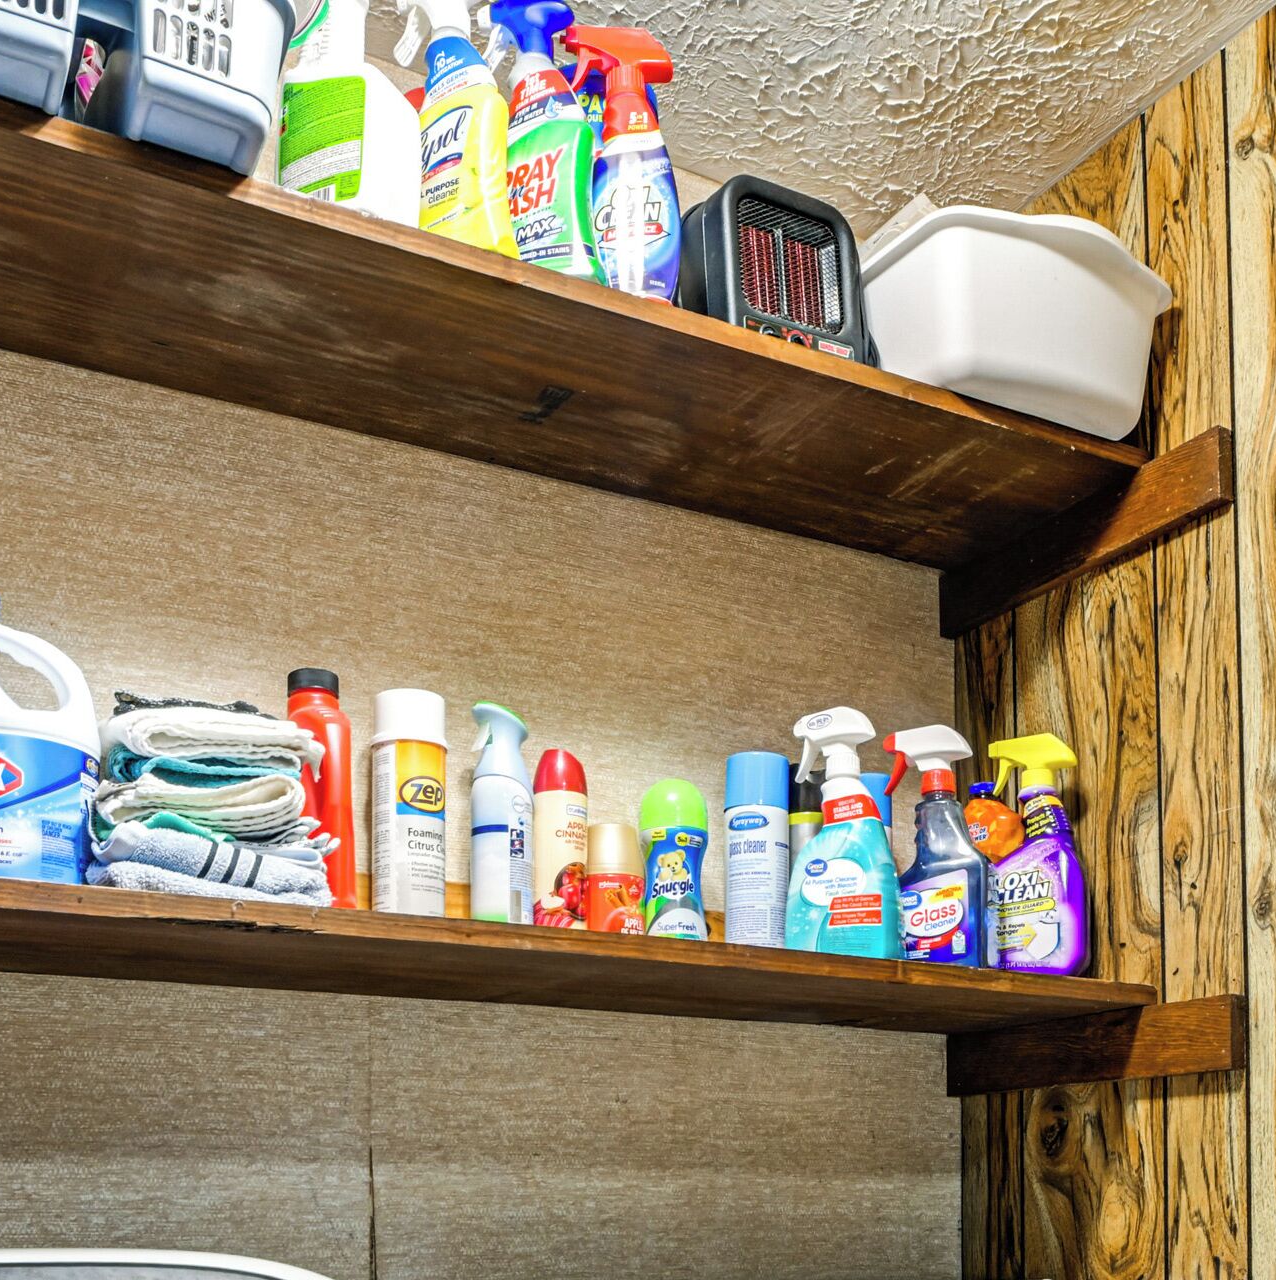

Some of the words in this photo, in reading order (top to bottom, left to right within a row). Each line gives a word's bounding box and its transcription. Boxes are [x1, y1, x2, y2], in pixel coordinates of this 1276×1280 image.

[521, 79, 546, 100] TIME
[426, 178, 460, 196] PURPOSE
[428, 187, 459, 204] cleaner
[516, 215, 556, 242] MAX
[548, 246, 570, 256] STAINS
[833, 805, 850, 814] STAINS
[834, 809, 863, 820] DISINFECTS
[732, 816, 766, 828] Sprayway
[408, 827, 442, 842] Foaming
[555, 829, 586, 840] CINNA
[408, 840, 434, 852] Citrus
[730, 840, 742, 858] glass
[743, 840, 766, 854] cleaner
[1004, 870, 1040, 890] OXI
[652, 880, 694, 898] Snuggle
[998, 881, 1050, 904] CLEAN
[910, 904, 956, 926] Glass
[924, 916, 956, 932] Cleaner
